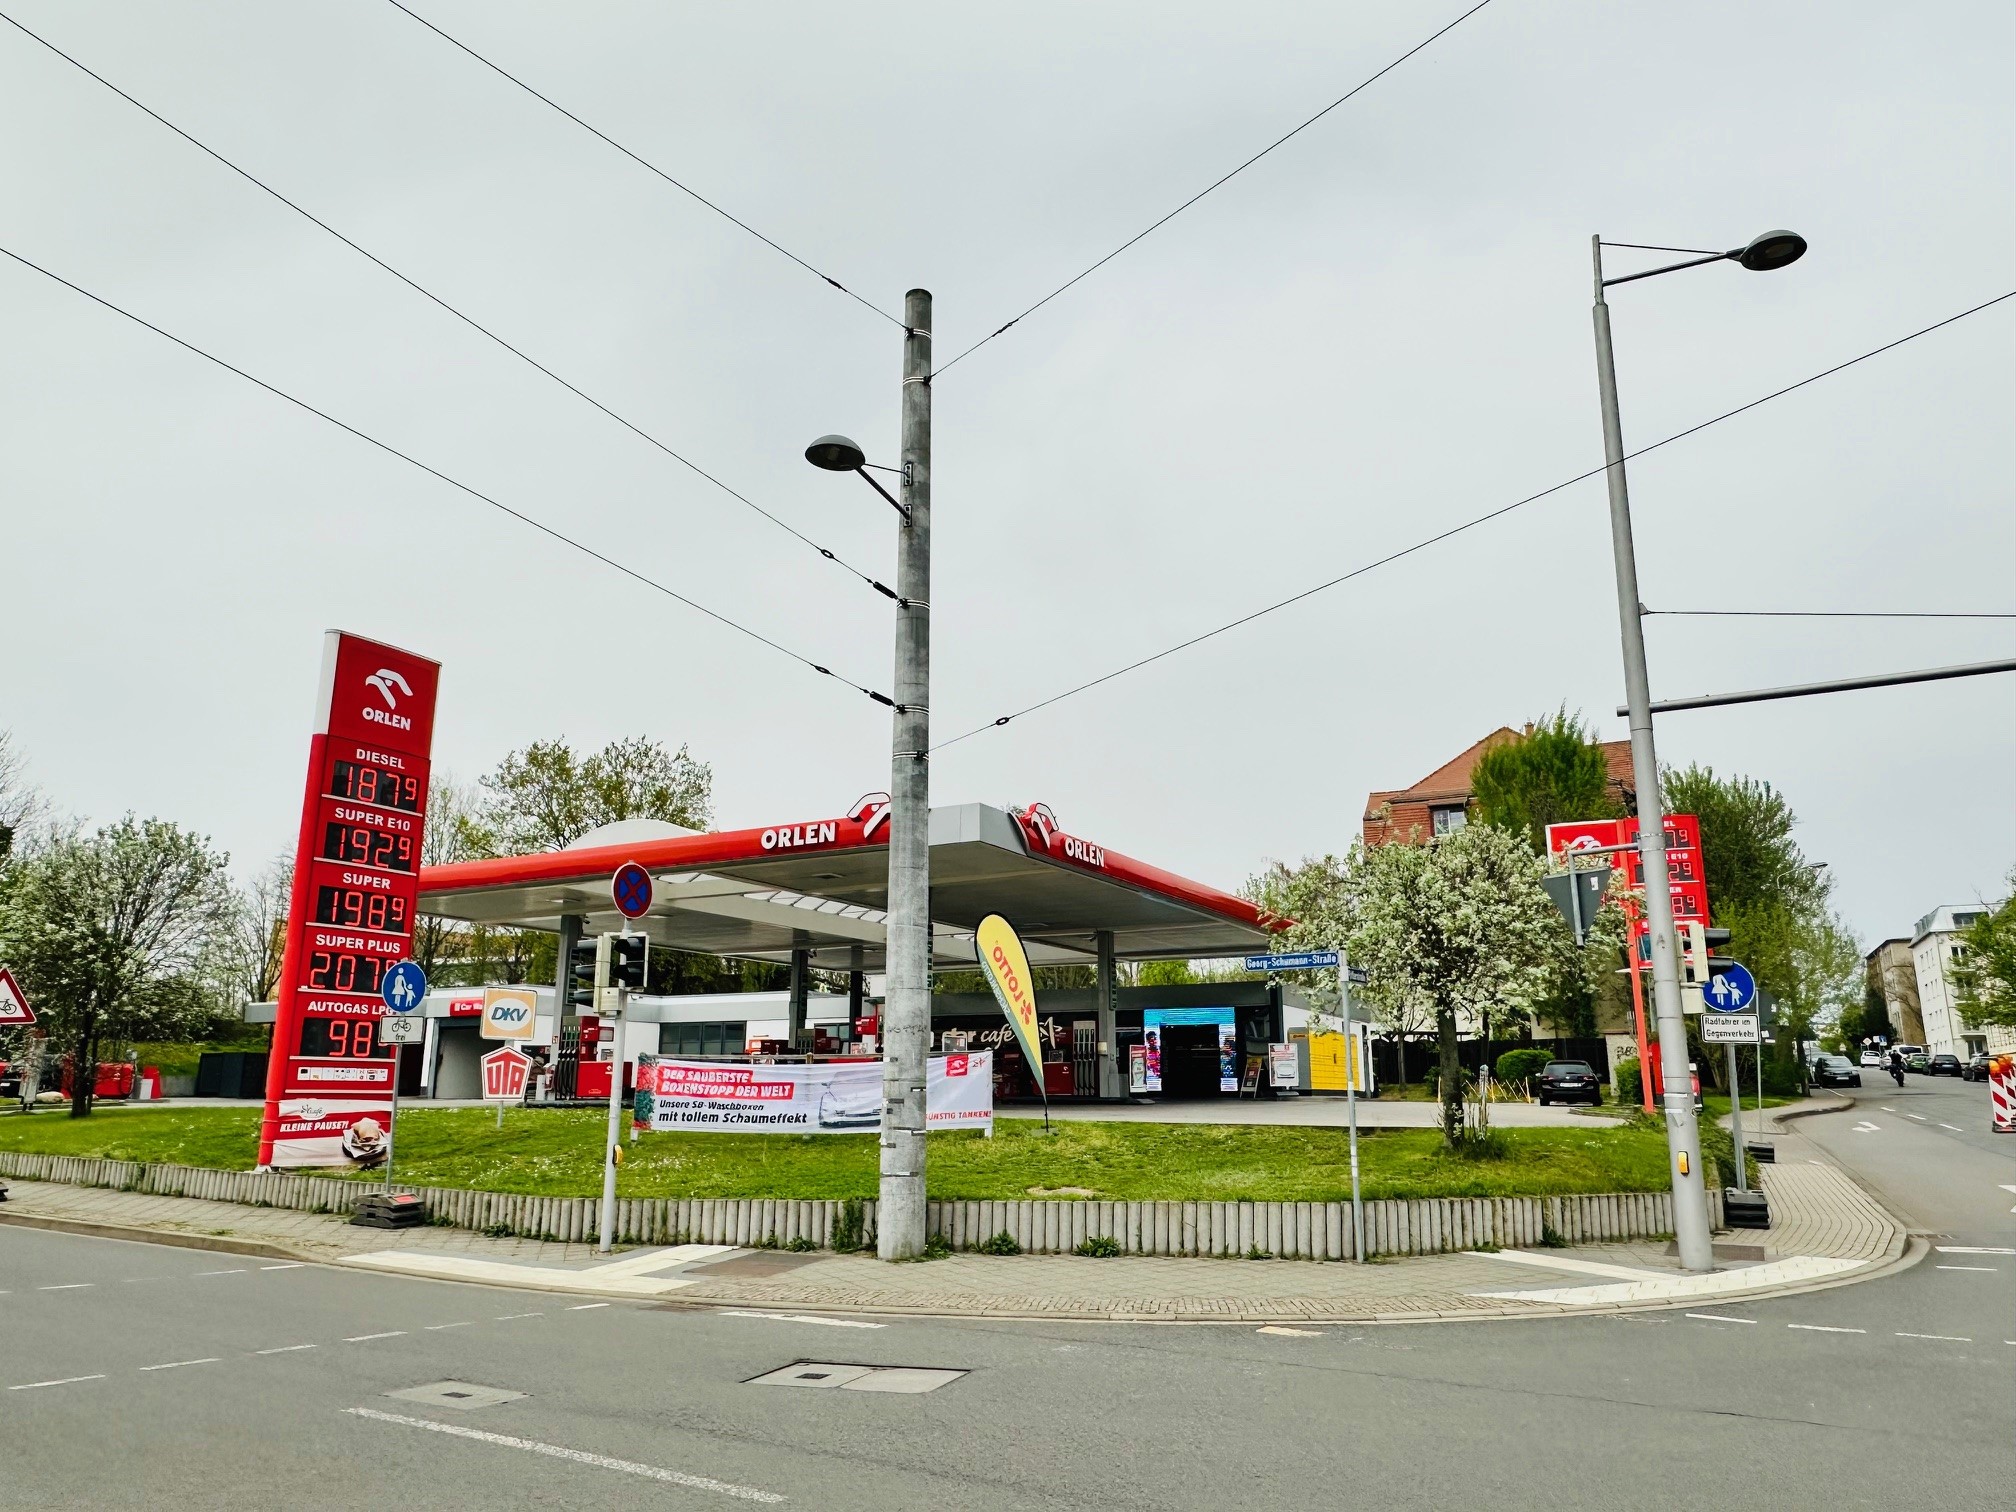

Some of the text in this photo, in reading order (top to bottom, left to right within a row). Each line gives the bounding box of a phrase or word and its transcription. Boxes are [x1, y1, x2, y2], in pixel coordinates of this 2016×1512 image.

[362, 706, 411, 731] ORLEN
[356, 748, 405, 770] DIESEL
[346, 766, 417, 806] 1879
[335, 807, 411, 831] SUPER E10
[760, 821, 837, 850] ORLEN
[339, 827, 411, 869] 1929
[1064, 836, 1105, 868] ORLEN
[342, 872, 391, 890] SUPER
[332, 891, 405, 929] 1989
[315, 934, 401, 954] SUPER PLUS
[1246, 954, 1337, 969] Georg-Schumann-Straße
[307, 1001, 369, 1015] AUTOGAS
[491, 1006, 528, 1022] DKV
[1705, 1017, 1740, 1026] Radfahrer
[329, 1020, 373, 1057] 98
[980, 1023, 1016, 1051] café
[1706, 1029, 1755, 1039] Gegenverkehr
[486, 1051, 528, 1096] UTA
[662, 1068, 750, 1083] DER SAUBERSTE
[661, 1081, 792, 1097] BOXENSTOPP DER WELT
[659, 1100, 765, 1111] Unsere SB-Waschboxen
[958, 1110, 992, 1119] TANKEN!
[280, 1121, 313, 1133] KLEINE
[658, 1111, 808, 1124] mit tollem Schaumeffekt
